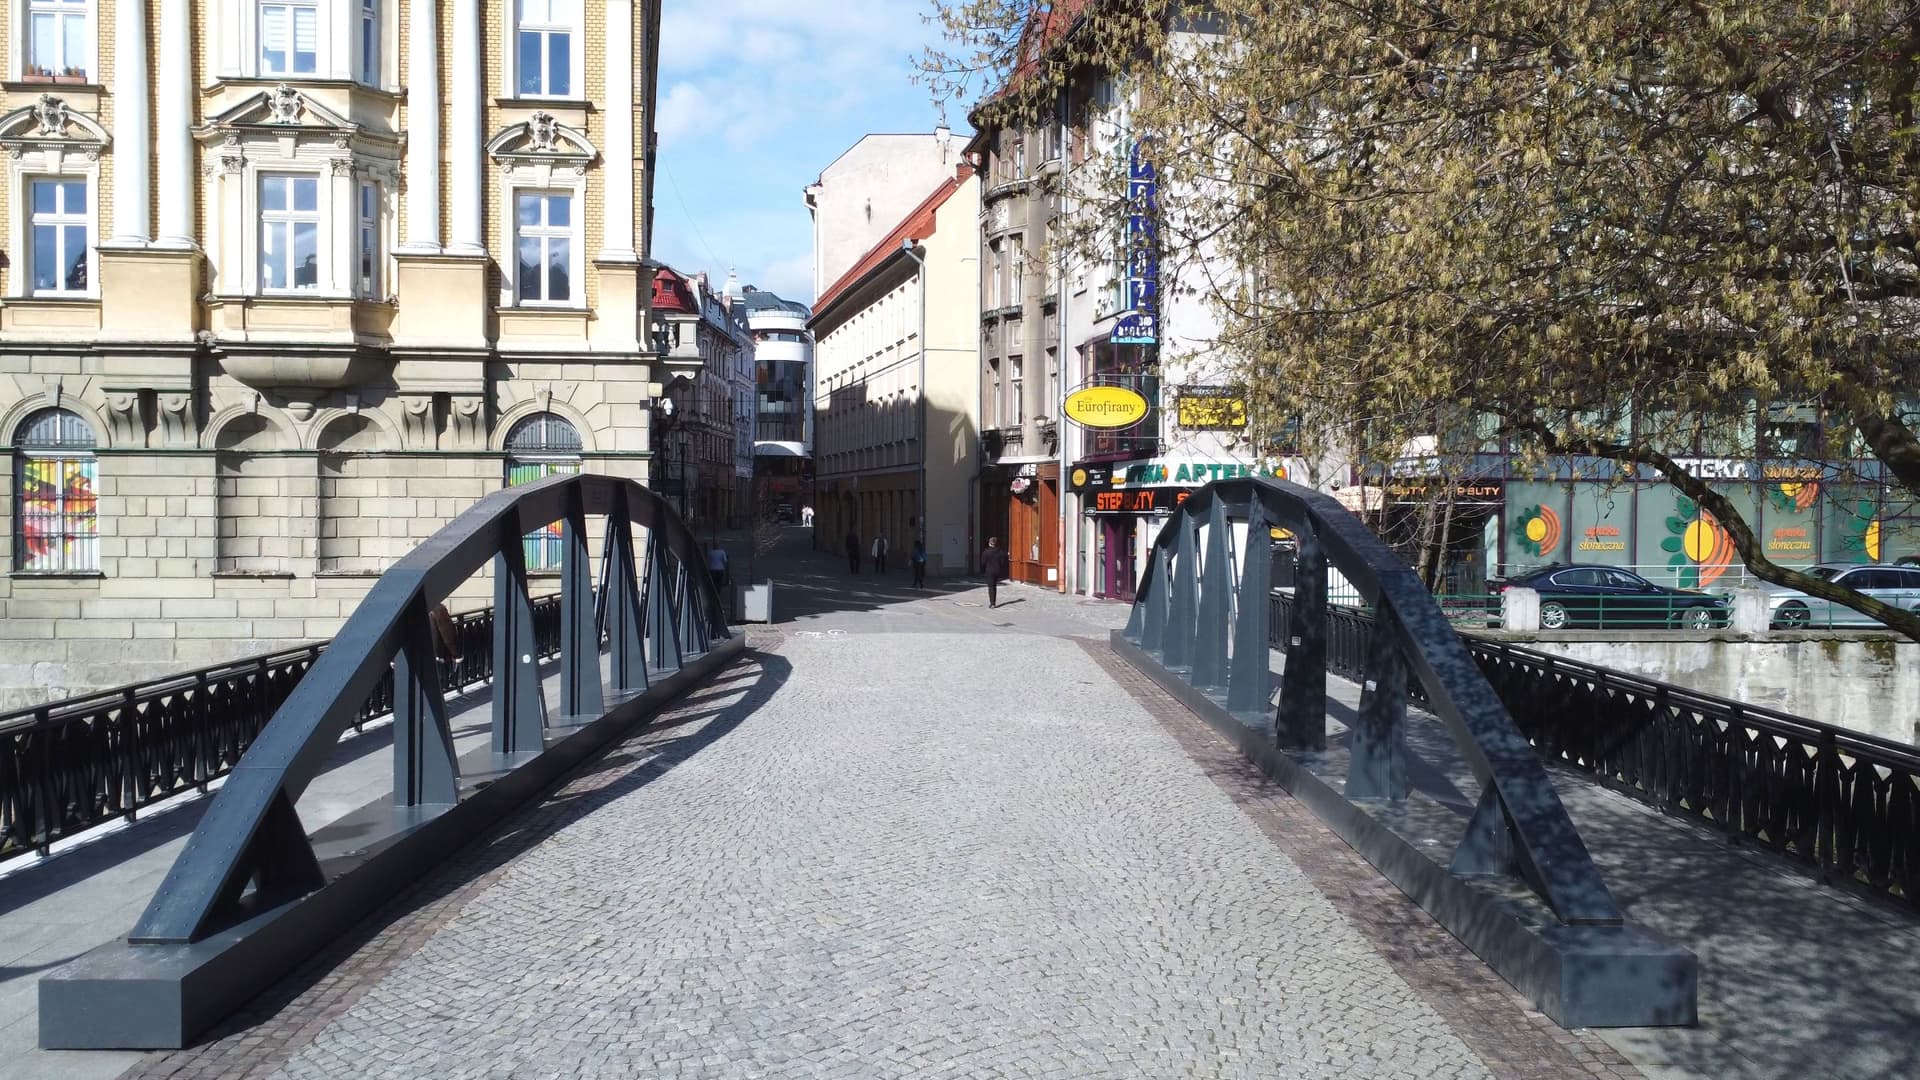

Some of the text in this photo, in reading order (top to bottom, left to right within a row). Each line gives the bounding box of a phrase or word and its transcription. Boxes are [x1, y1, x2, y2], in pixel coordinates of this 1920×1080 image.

[1077, 400, 1136, 415] Eurofirany
[1467, 486, 1500, 496] BUTY
[1097, 492, 1123, 510] STEP
